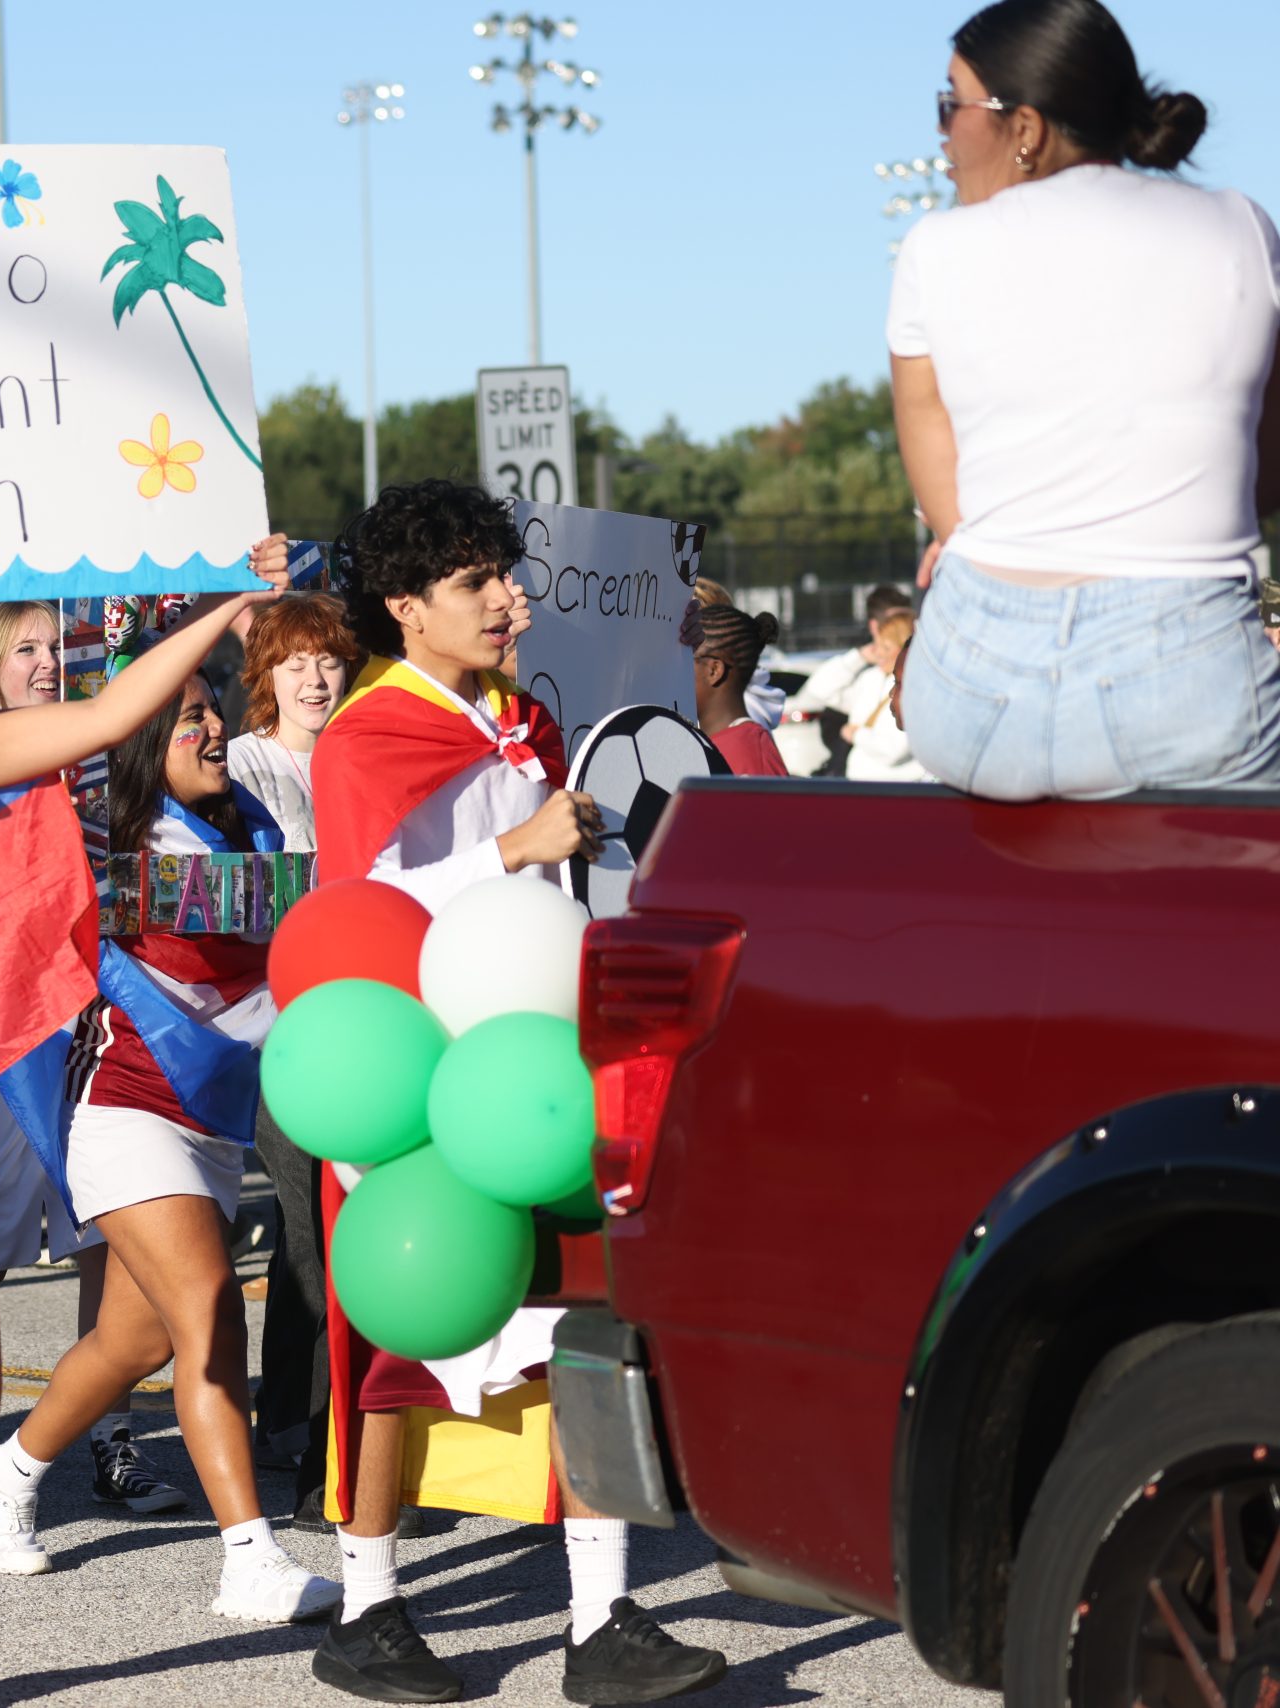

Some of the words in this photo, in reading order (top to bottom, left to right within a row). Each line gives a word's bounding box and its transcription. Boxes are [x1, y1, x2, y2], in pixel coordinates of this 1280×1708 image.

[486, 387, 563, 415] SPEED
[496, 423, 556, 451] LIMIT
[139, 850, 318, 935] LATIN
